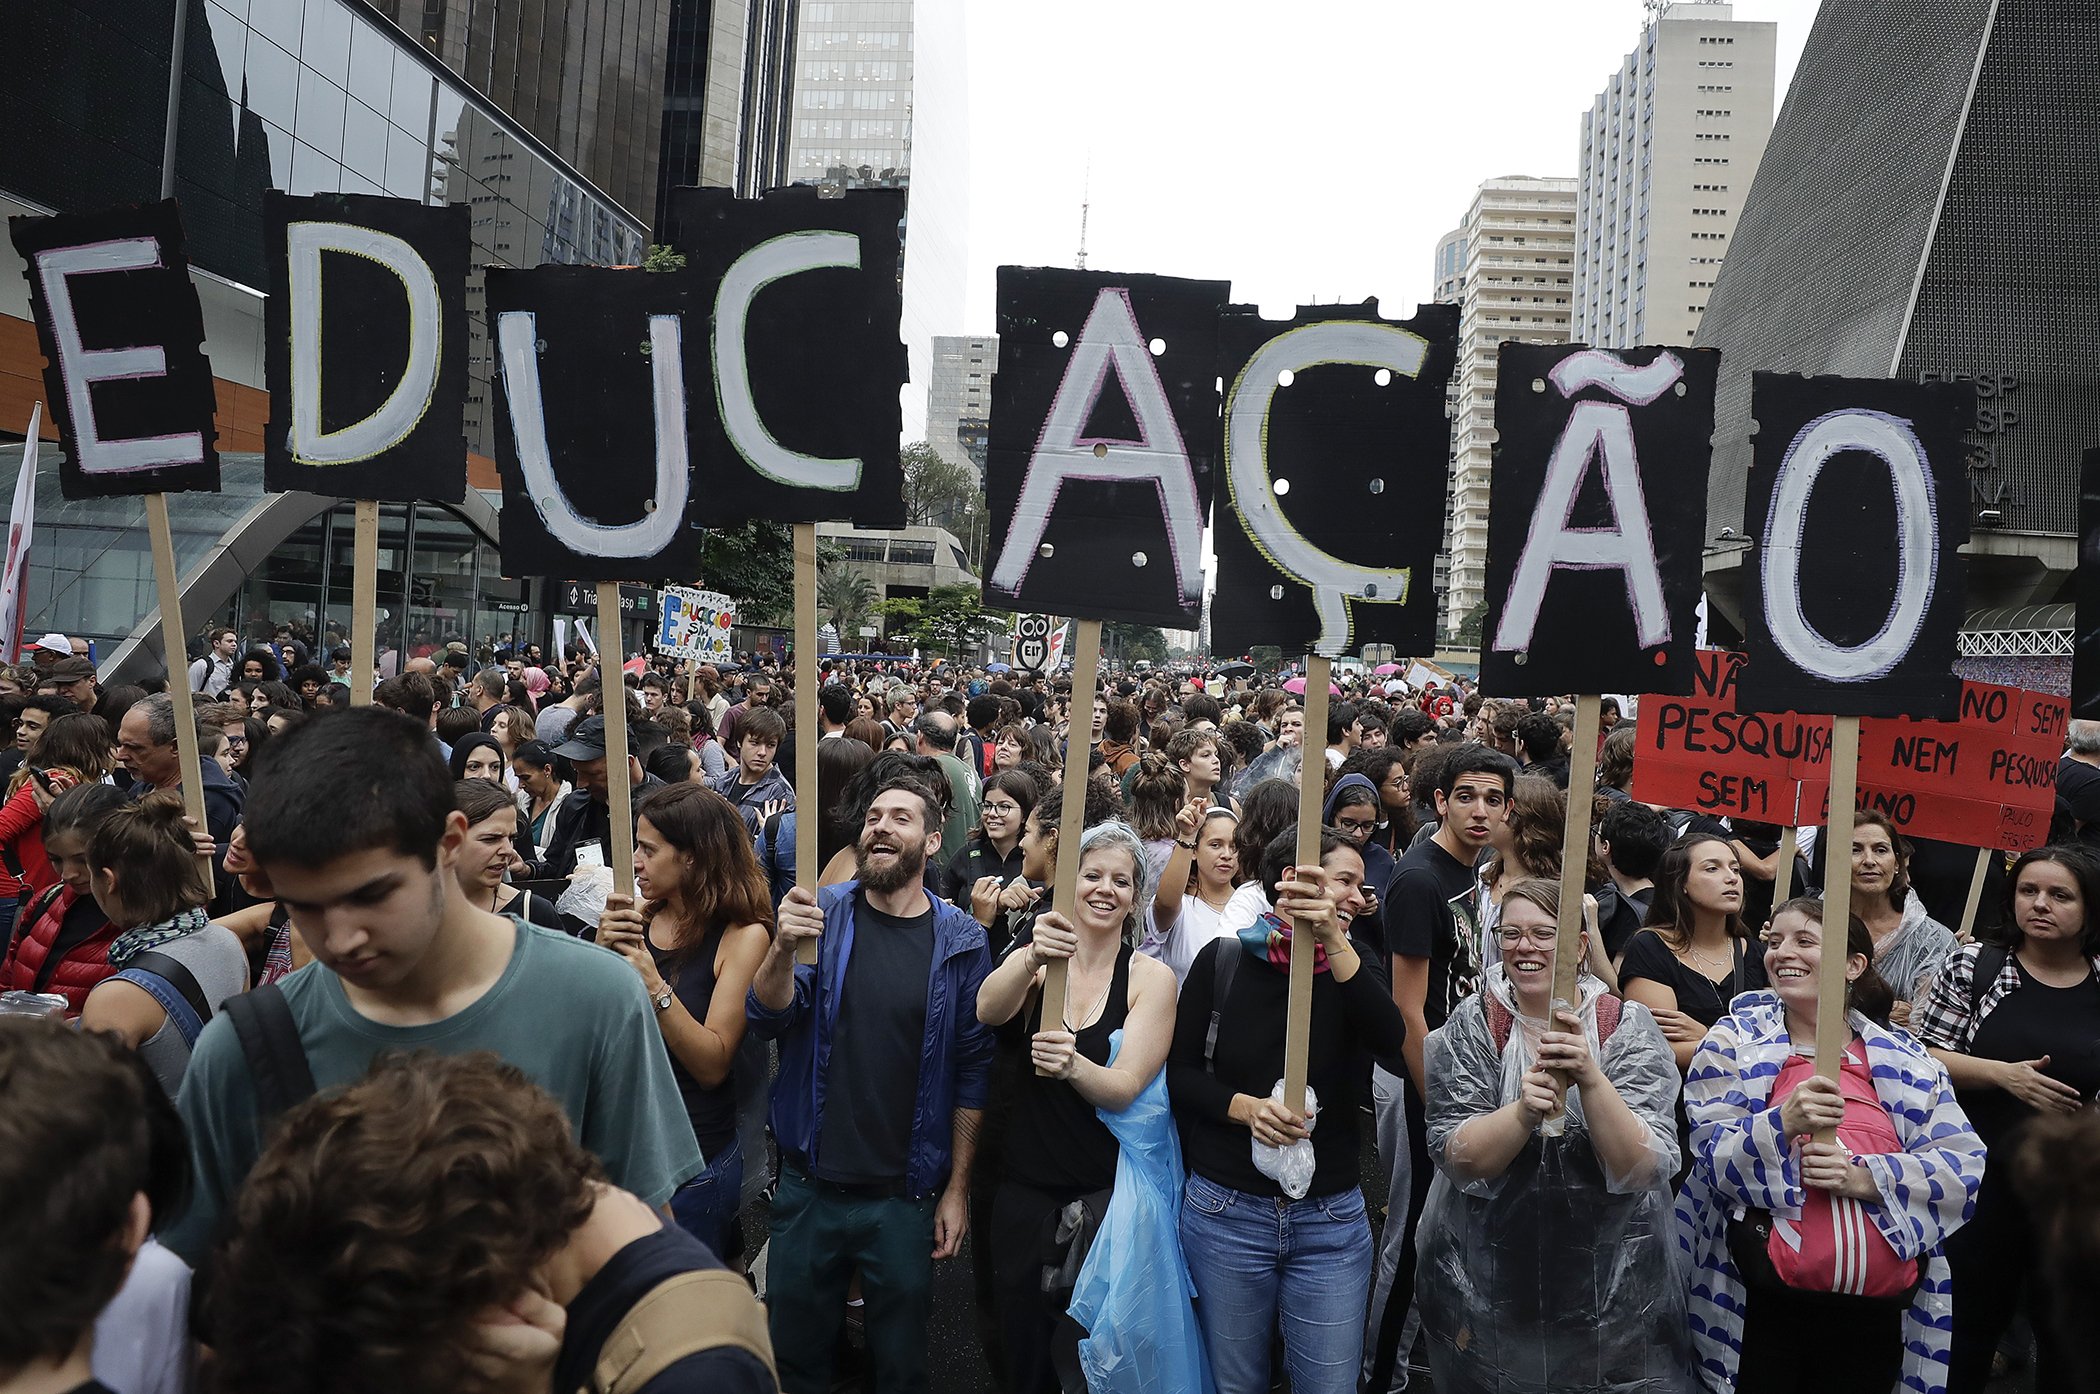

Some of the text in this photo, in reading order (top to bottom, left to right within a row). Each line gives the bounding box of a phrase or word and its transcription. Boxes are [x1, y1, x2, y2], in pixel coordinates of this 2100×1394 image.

[1970, 479, 2026, 506] NAI
[498, 603, 520, 611] Acesso
[1695, 653, 2065, 737] NÃ NO SEM
[1656, 704, 1832, 765] PESQUISA
[1892, 736, 1959, 776] NEM
[1989, 748, 2058, 789] PESQUISA
[1696, 770, 1768, 815] SEM
